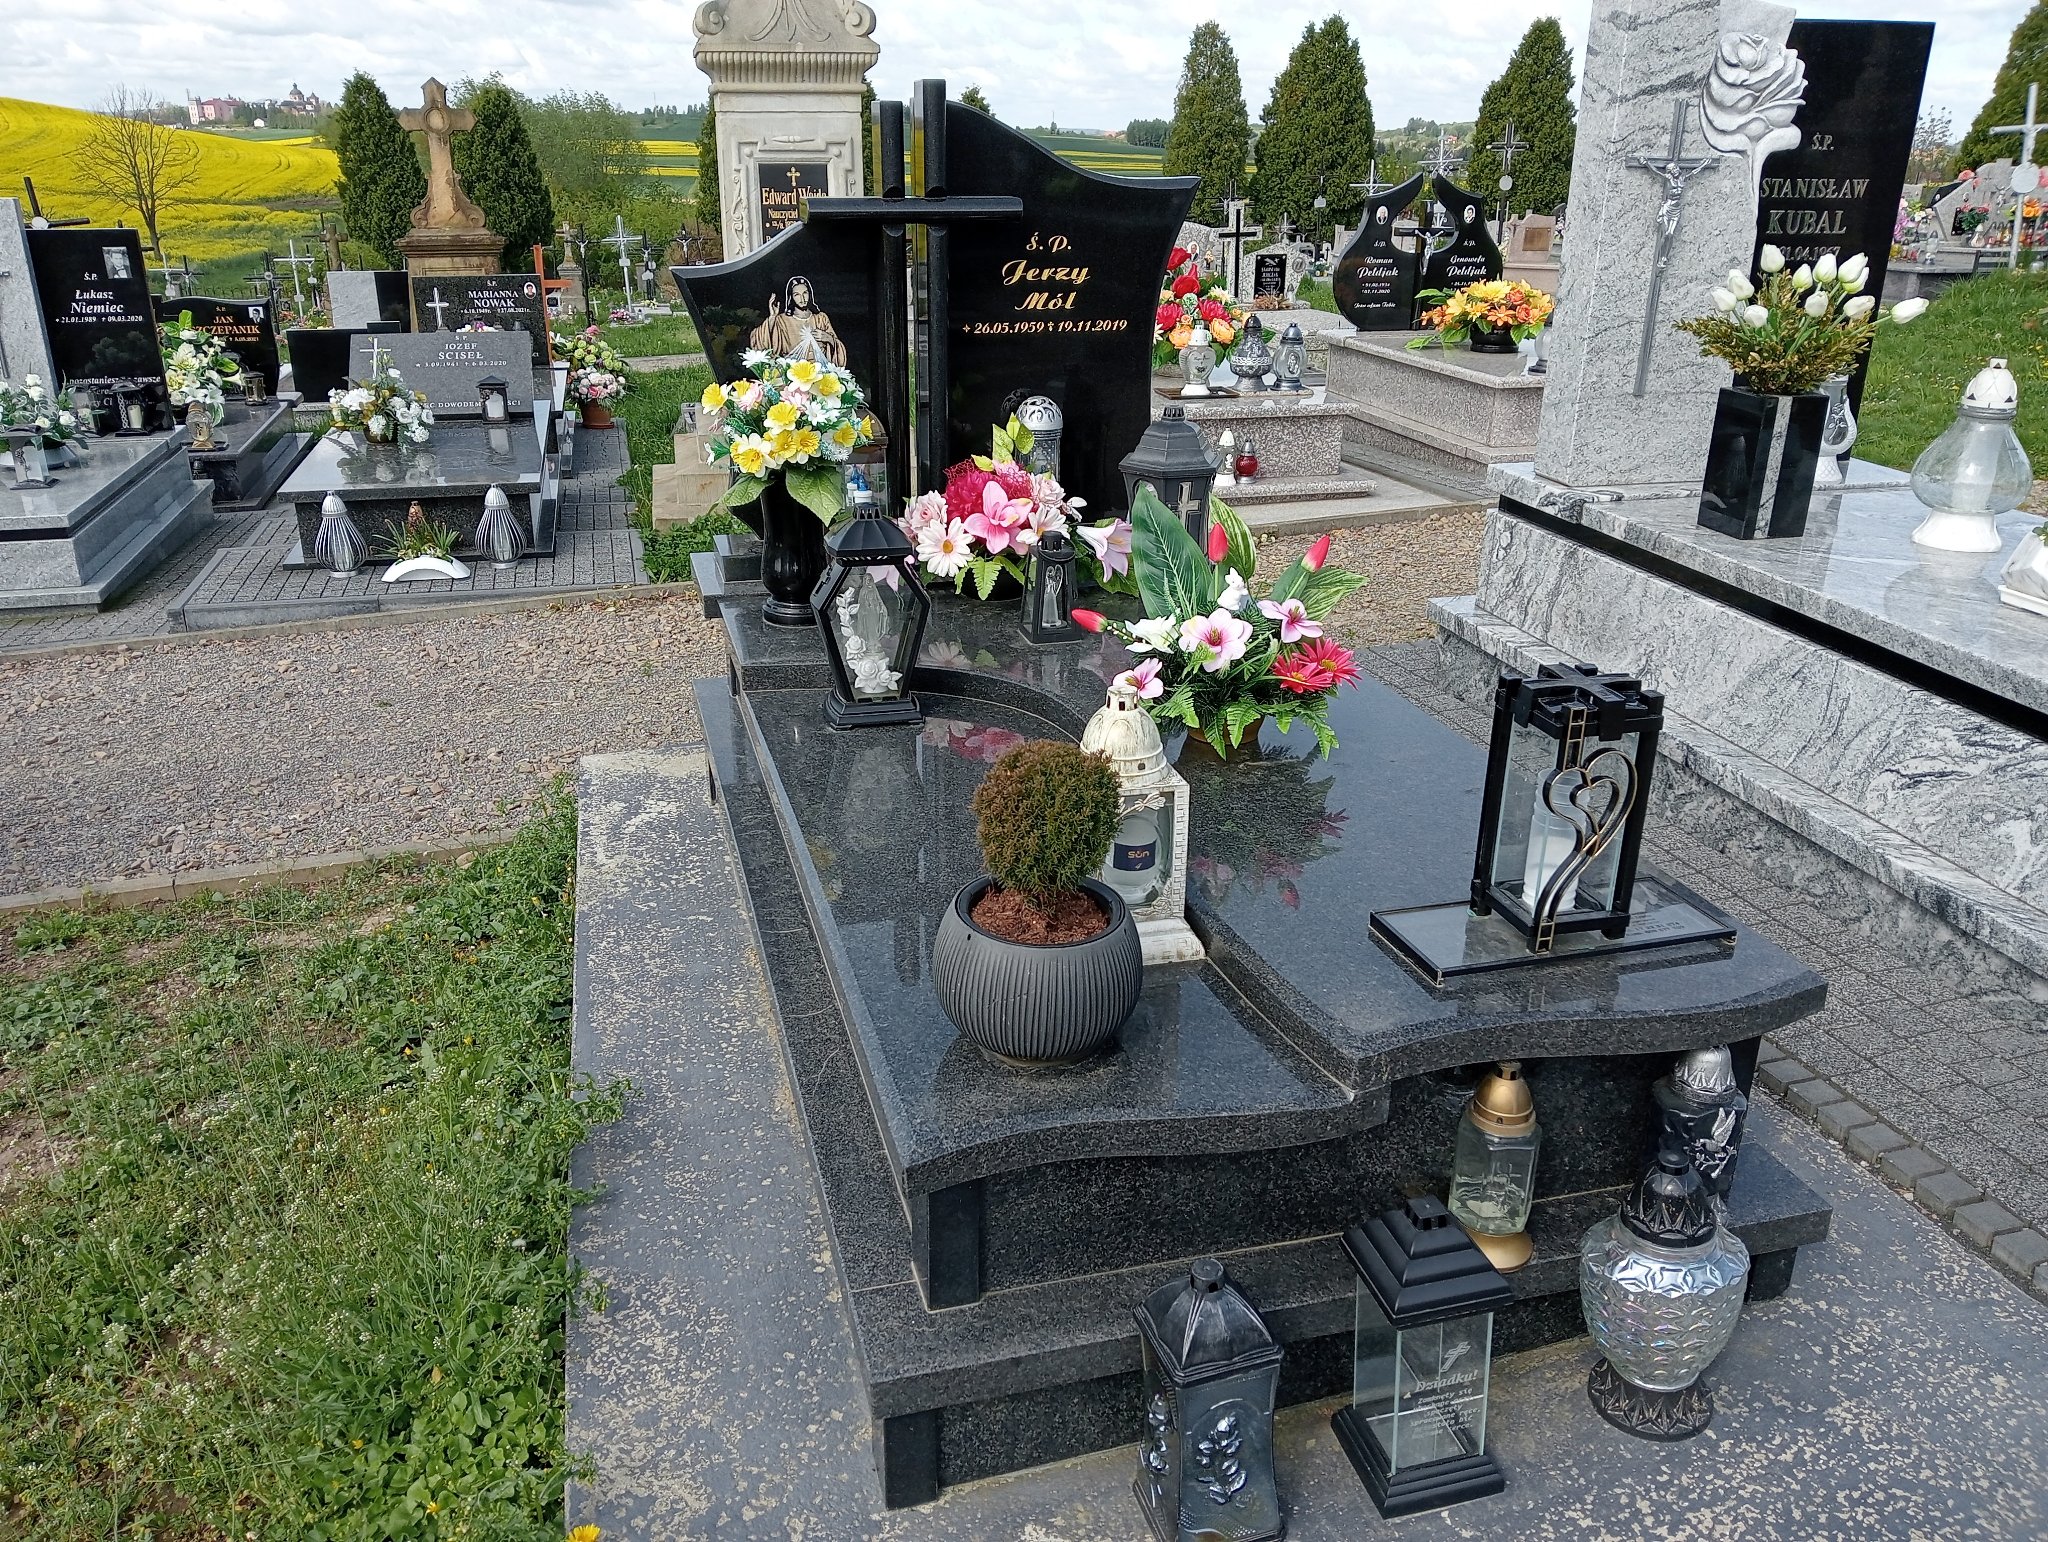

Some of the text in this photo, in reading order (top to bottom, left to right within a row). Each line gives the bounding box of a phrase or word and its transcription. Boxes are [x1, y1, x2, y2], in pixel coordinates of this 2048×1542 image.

[1760, 178, 1870, 199] STANISŁAW
[761, 187, 797, 205] Edward
[768, 208, 798, 221] Nauczyciel
[1765, 210, 1847, 235] KUBAL
[1048, 235, 1072, 252] P.
[1364, 256, 1394, 264] Roman
[1450, 254, 1486, 264] Genowefa
[1001, 259, 1091, 286] Jerzy
[75, 289, 114, 300] Łukasz
[468, 290, 519, 299] MARIANNA
[1014, 291, 1077, 310] Mól
[70, 301, 124, 314] Niemiec
[474, 298, 515, 308] NOWAK
[213, 315, 234, 324] JAN
[973, 319, 1128, 334] 26.05.1959 19.11.2019
[1414, 1369, 1479, 1392] Dziadku!
